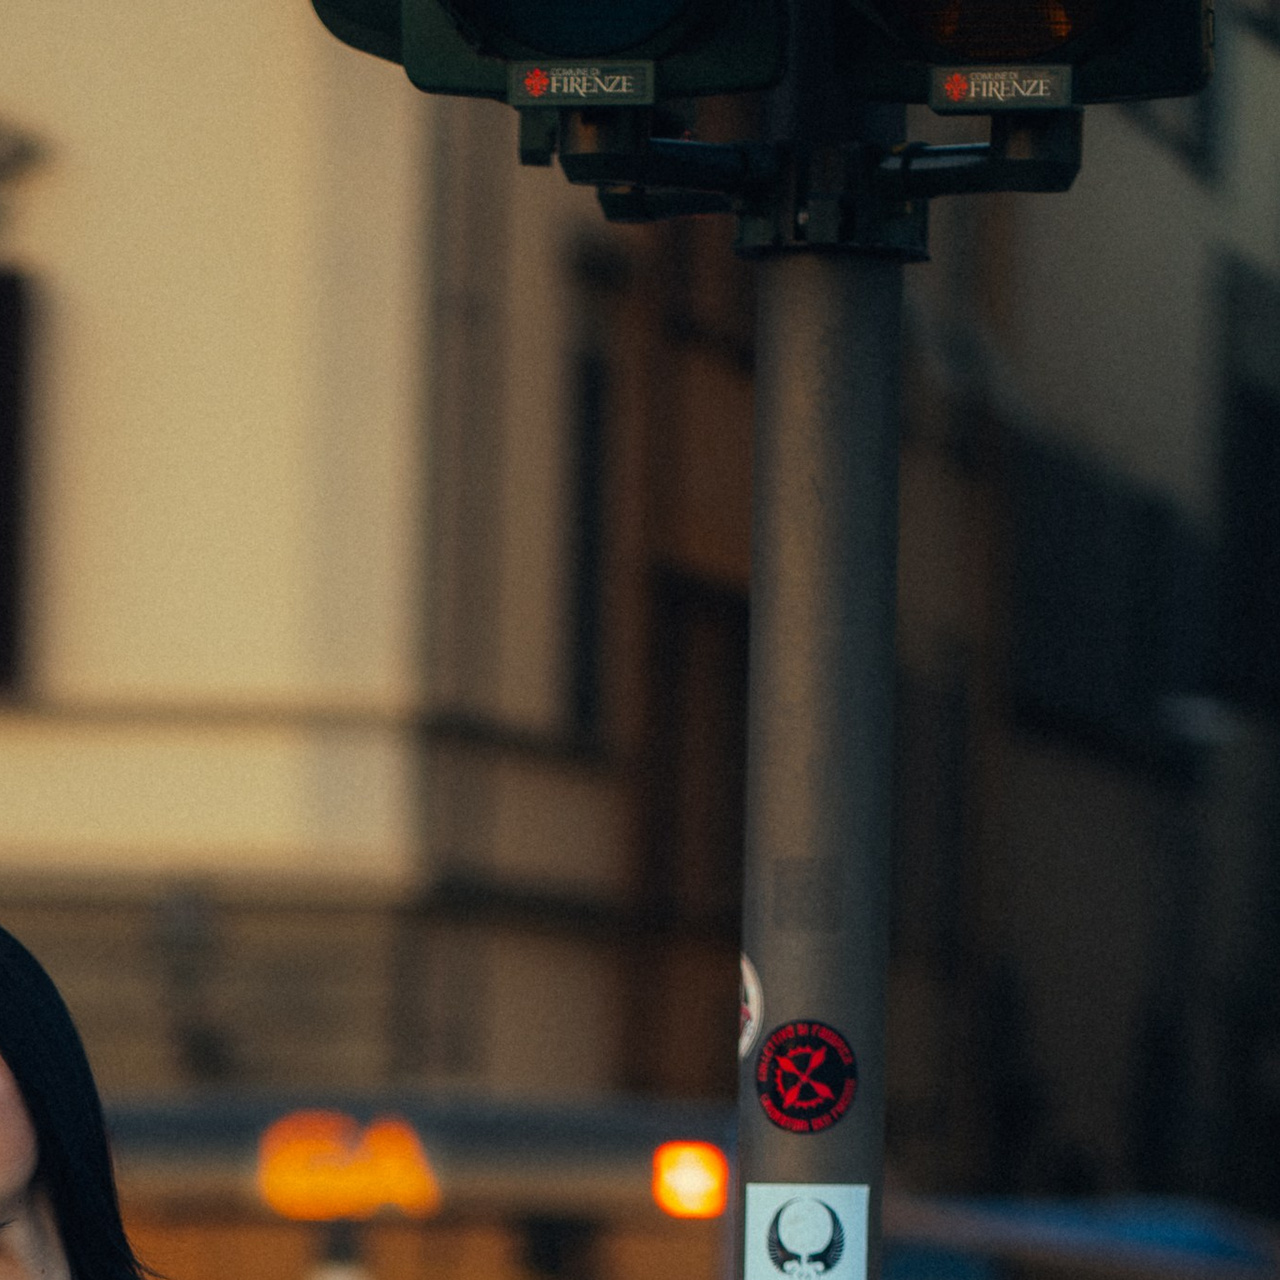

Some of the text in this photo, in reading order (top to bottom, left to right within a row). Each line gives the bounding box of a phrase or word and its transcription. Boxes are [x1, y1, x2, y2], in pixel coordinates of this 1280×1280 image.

[550, 75, 634, 97] FIRENZE
[970, 71, 1008, 80] COMUNE
[970, 79, 1052, 101] FIRENZE
